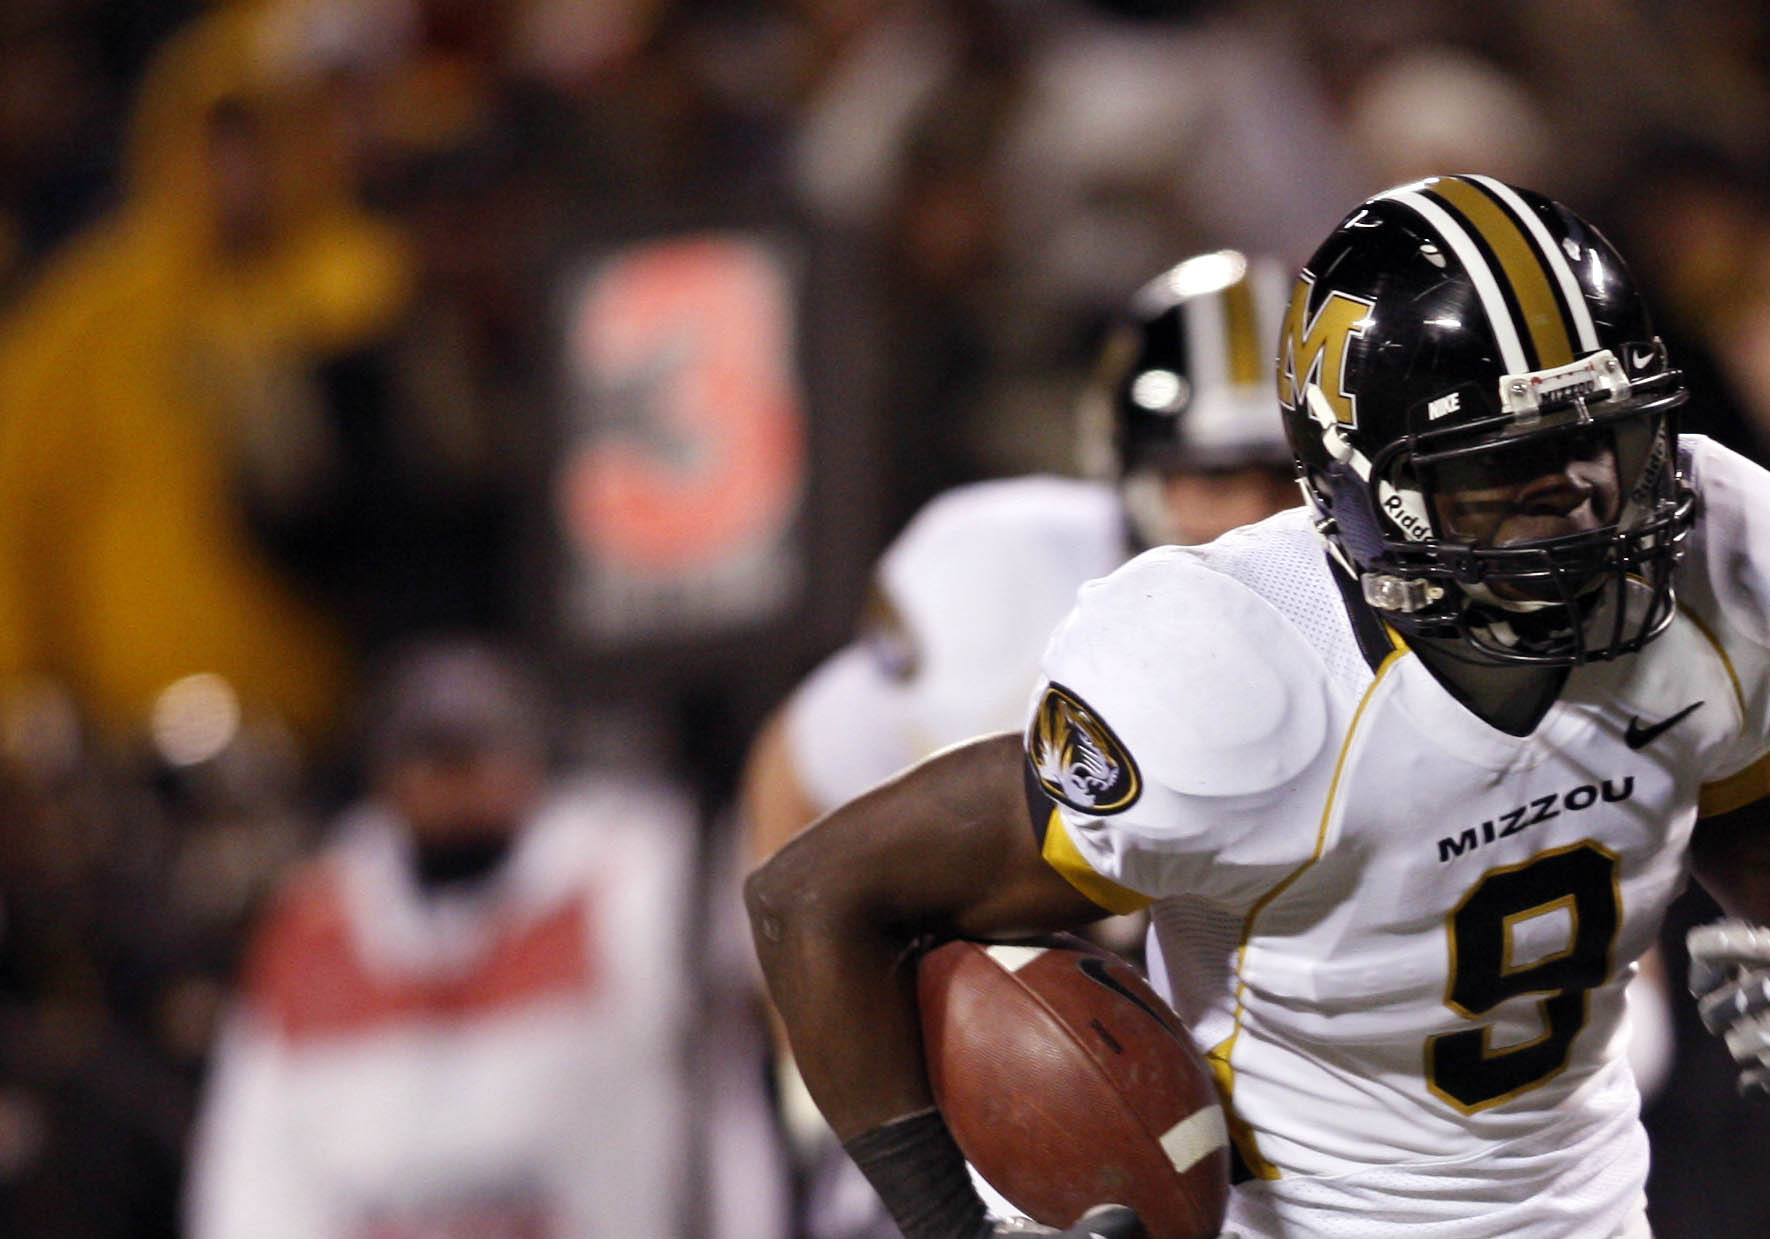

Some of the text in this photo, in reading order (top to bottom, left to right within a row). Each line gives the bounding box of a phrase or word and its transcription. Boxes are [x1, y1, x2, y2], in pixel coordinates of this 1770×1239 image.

[560, 238, 804, 572] 3
[1277, 267, 1376, 430] M
[1384, 495, 1432, 541] Ridd
[1437, 776, 1635, 862] MIZZOU
[1424, 837, 1623, 1116] 9
